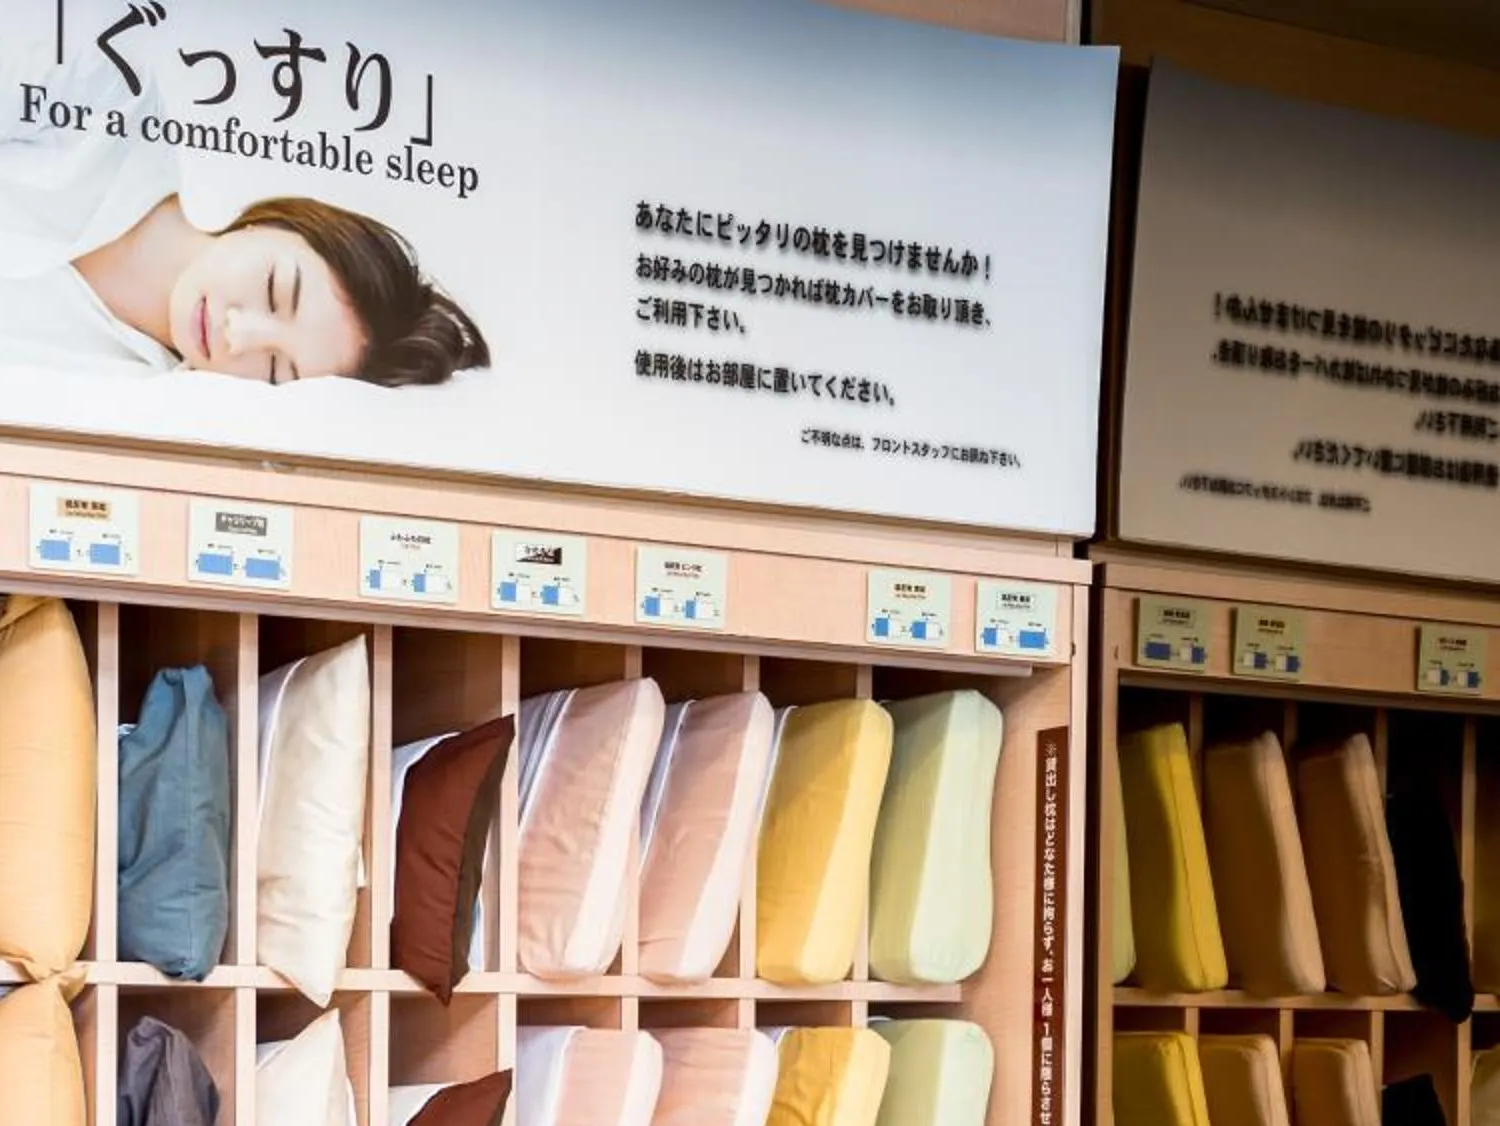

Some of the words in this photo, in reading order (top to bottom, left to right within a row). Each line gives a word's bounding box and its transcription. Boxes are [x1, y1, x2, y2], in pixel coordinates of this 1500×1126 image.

[19, 83, 93, 131] For
[105, 110, 129, 138] a
[140, 115, 374, 175] comfortable
[385, 146, 480, 198] sleep
[634, 200, 993, 280] あなたにピッタリの枕を見つけませんか！
[634, 252, 993, 328] お好みの枕が見つかれば枕カバーをお取り頂き、
[636, 296, 746, 334] ご利用下さい。
[634, 349, 896, 406] 使用後はお部屋に置いてください。
